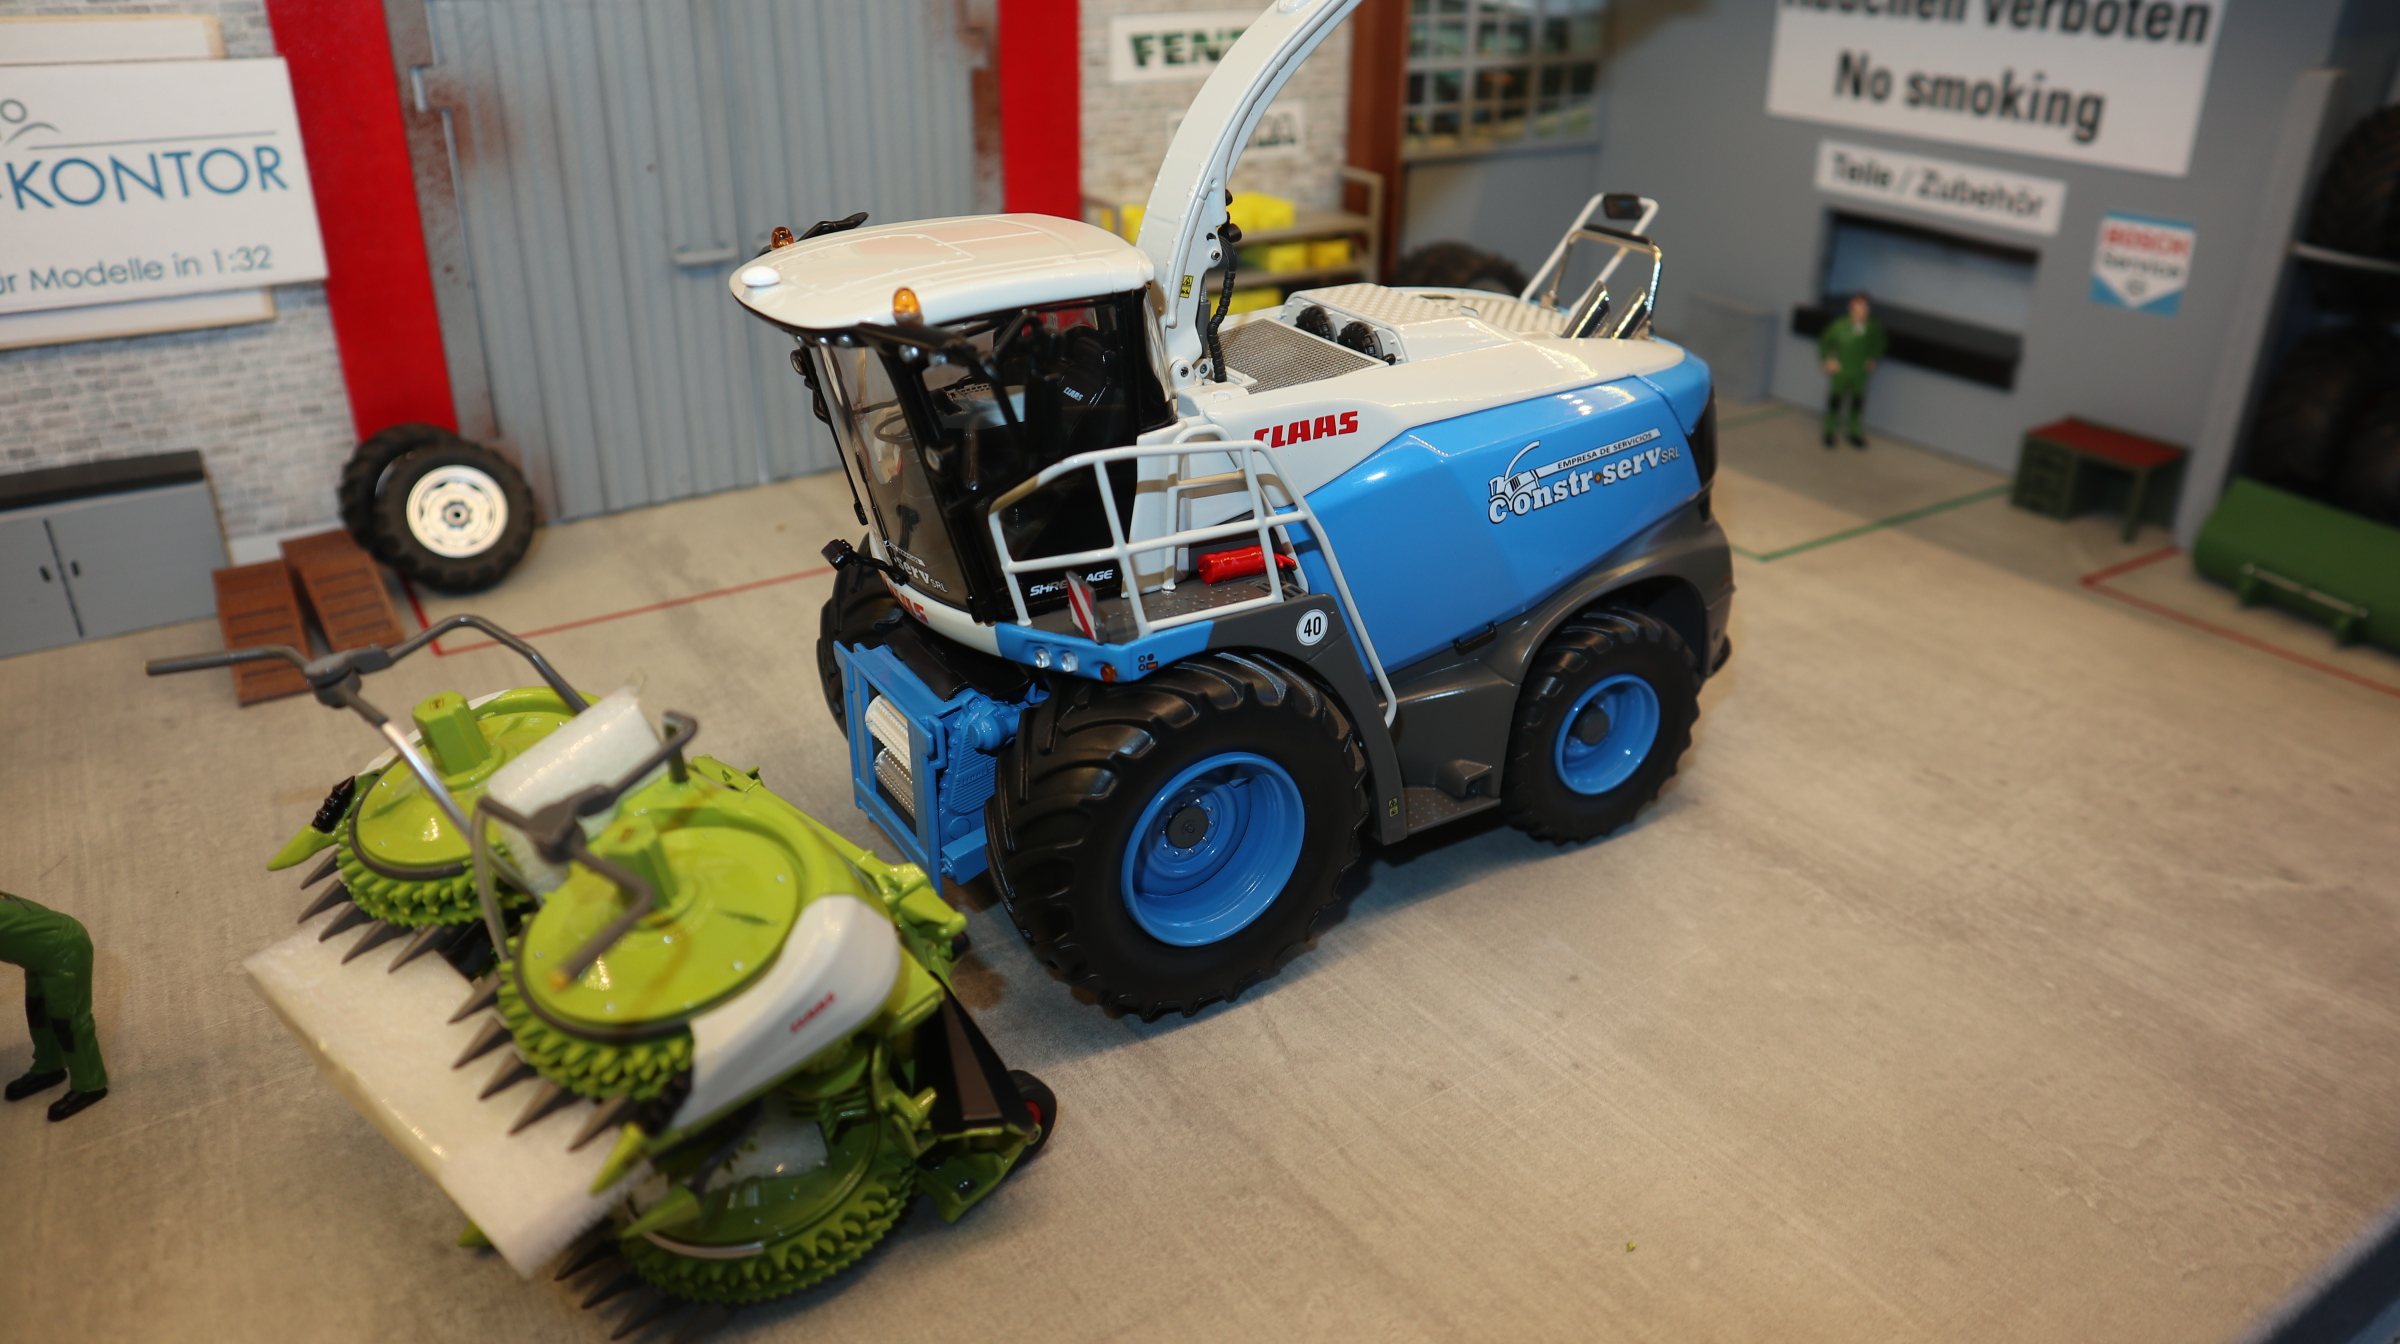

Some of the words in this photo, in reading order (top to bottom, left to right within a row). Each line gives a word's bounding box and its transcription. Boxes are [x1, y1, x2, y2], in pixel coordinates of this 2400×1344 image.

[1833, 49, 1893, 101] No
[1905, 69, 2106, 144] smoking
[0, 146, 289, 210] KONTOR
[1833, 151, 1891, 188] Teile
[29, 259, 164, 291] Modelle
[172, 252, 201, 277] in
[212, 245, 273, 274] 1:32
[1252, 411, 1358, 452] CLAAS
[1557, 451, 1597, 469] EMPRESA
[1600, 446, 1610, 455] DE
[1613, 432, 1652, 450] SERVICIOS
[1661, 446, 1680, 464] SRL
[1304, 616, 1321, 637] 40
